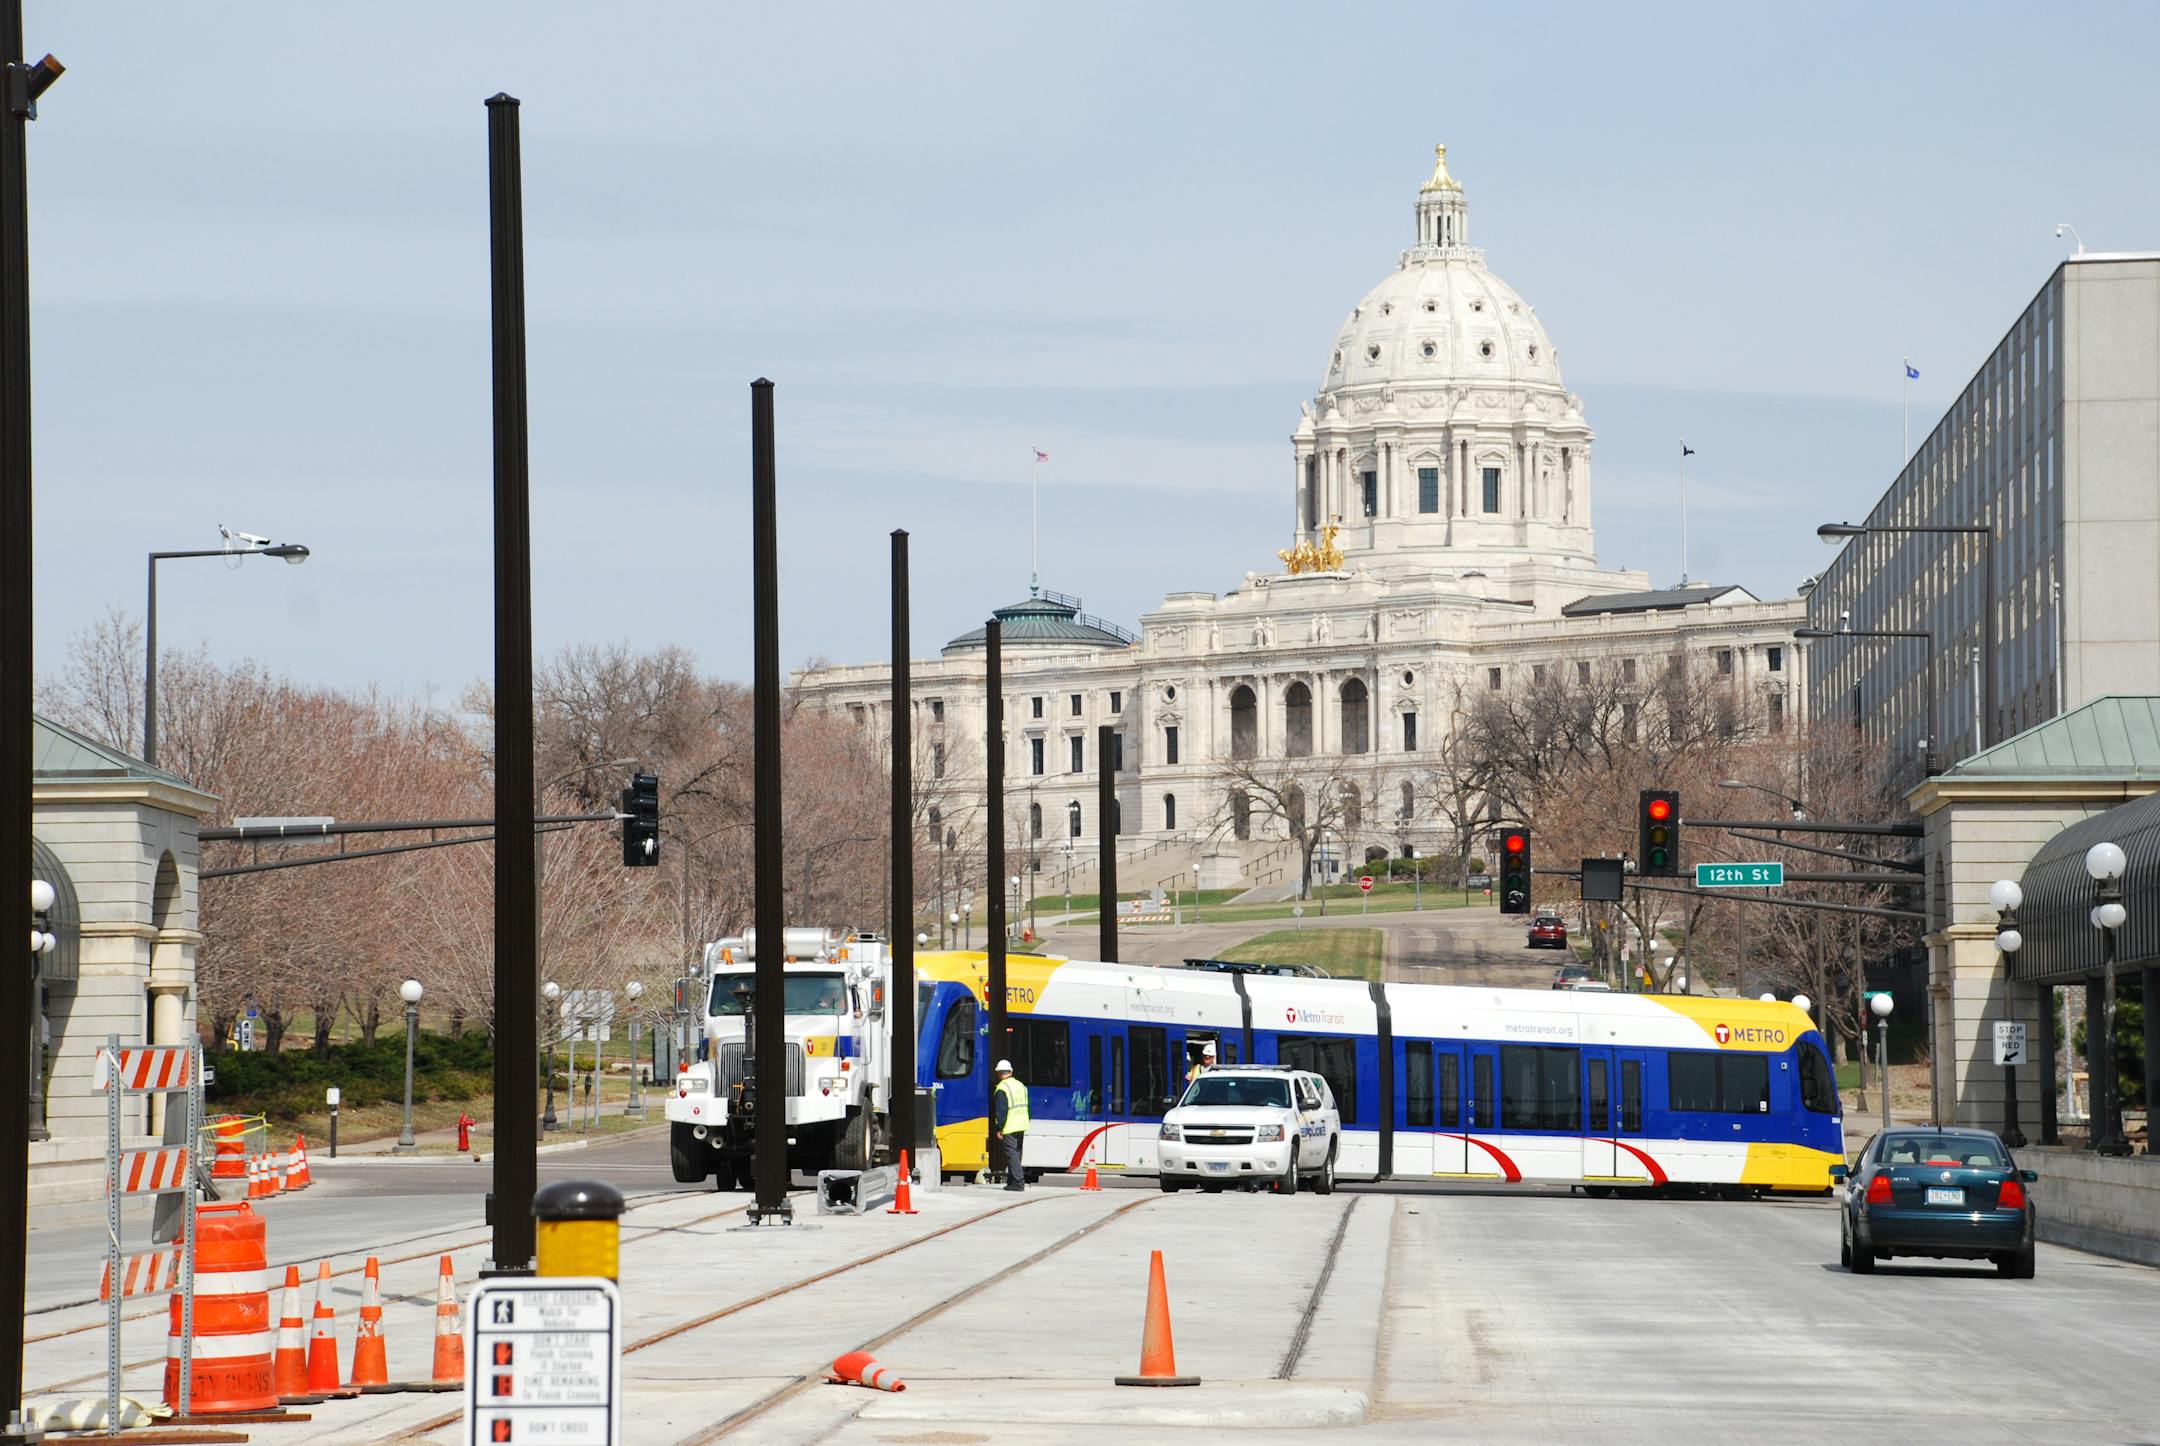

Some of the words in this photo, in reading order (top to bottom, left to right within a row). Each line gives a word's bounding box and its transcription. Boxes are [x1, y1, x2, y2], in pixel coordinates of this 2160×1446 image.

[1710, 869, 1743, 881] 12th
[1752, 869, 1769, 880] St
[1006, 987, 1034, 1004] ETRO
[1505, 1025, 1573, 1038] metrotransit.org
[1734, 1028, 1784, 1043] METRO
[560, 1422, 588, 1433] CROSS
